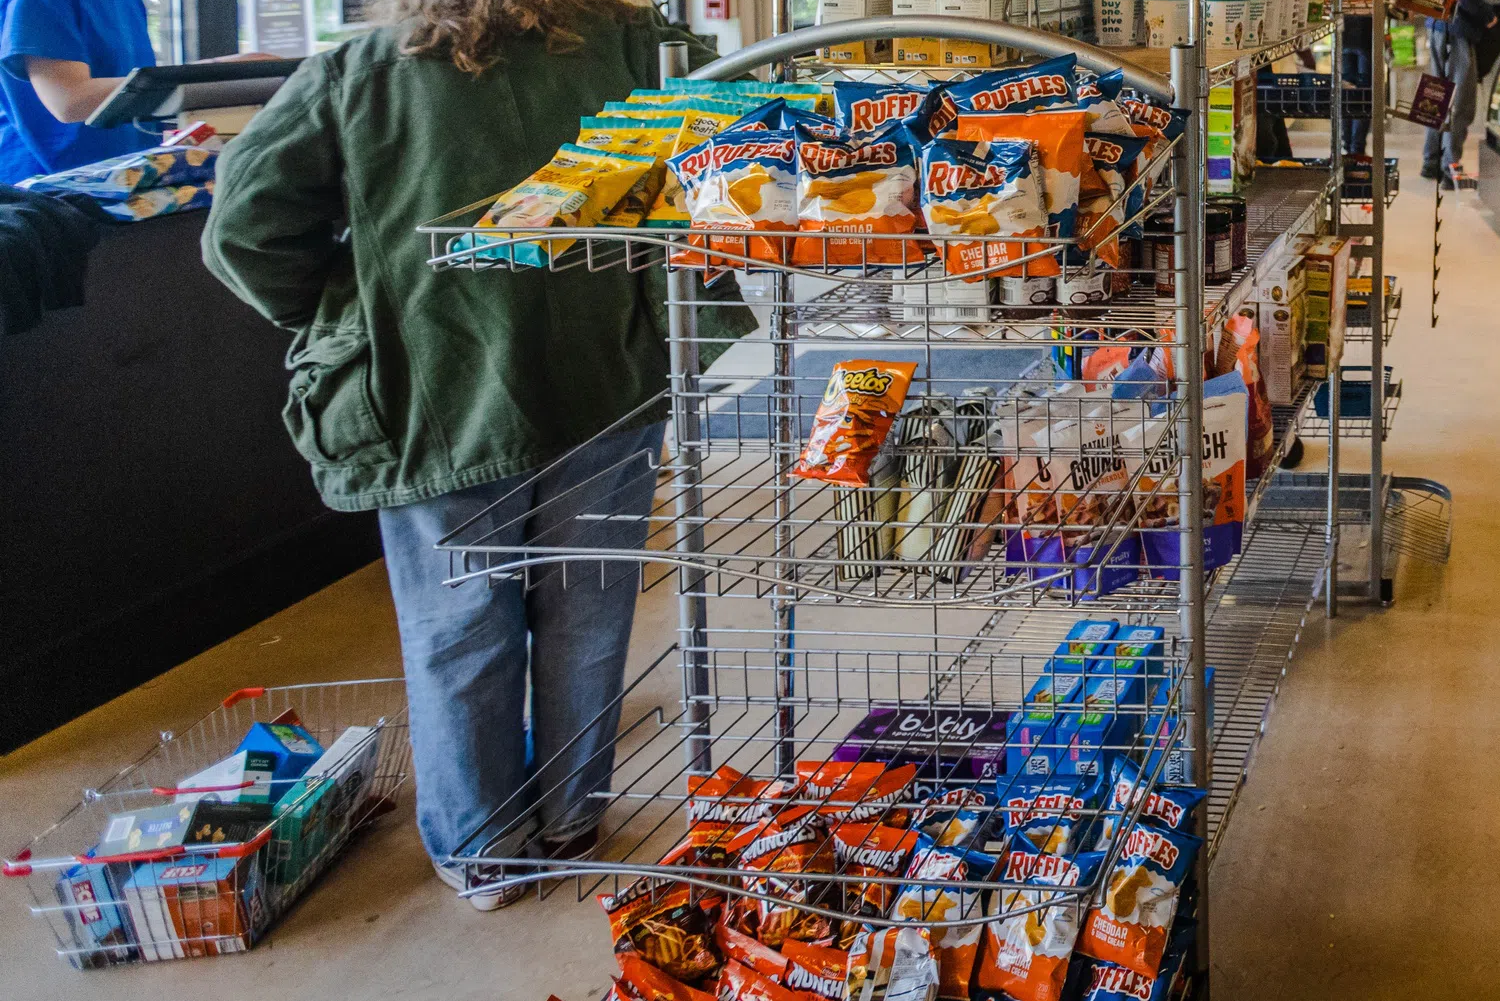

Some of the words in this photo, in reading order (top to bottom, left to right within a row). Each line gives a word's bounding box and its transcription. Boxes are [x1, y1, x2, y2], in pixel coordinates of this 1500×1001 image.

[1101, 0, 1121, 9] buy
[1101, 17, 1122, 26] give
[970, 74, 1069, 112] RUFFLES
[686, 123, 719, 136] health
[695, 116, 720, 128] good
[712, 139, 797, 170] RUFFLES
[801, 141, 897, 175] RUFFLES
[830, 237, 853, 245] SOUR
[690, 800, 773, 824] MUNCHIES
[1008, 794, 1084, 827] RUFFLES
[1093, 916, 1128, 939] CHEDDAR
[1096, 930, 1107, 942] SOUR
[1107, 934, 1125, 948] CREAM
